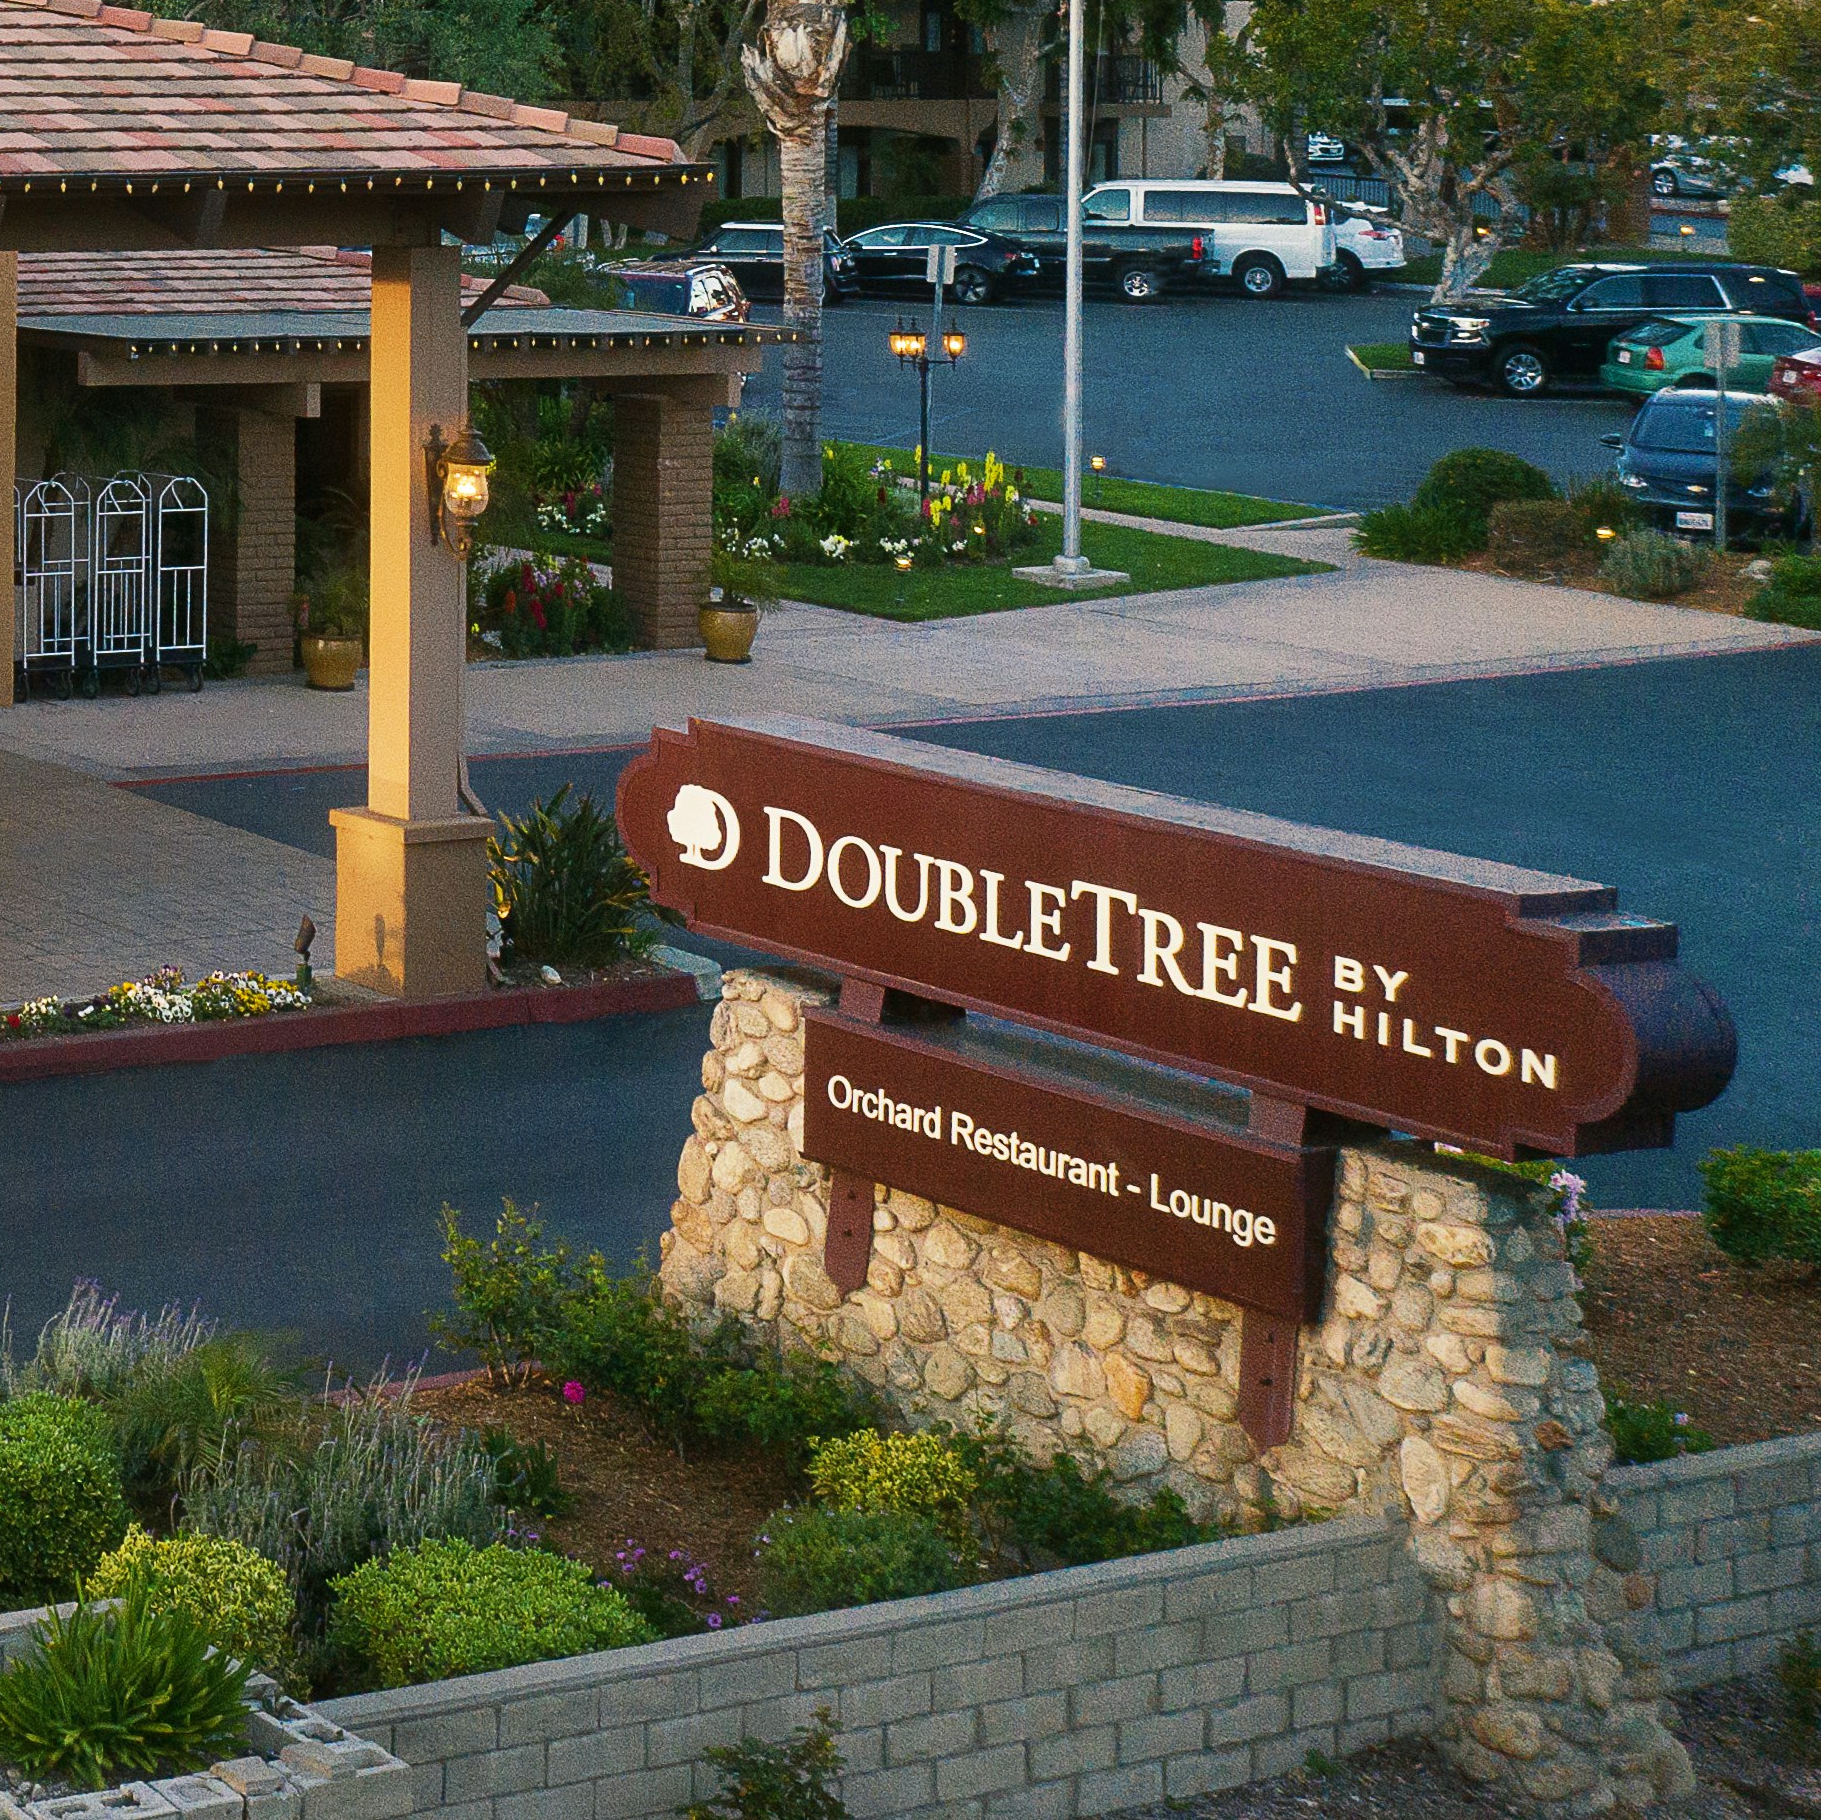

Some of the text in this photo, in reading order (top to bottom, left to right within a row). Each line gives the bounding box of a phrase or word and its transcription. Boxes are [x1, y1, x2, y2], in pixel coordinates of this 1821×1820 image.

[1333, 955, 1409, 1003] BY
[1333, 1001, 1557, 1090] HILTON
[827, 1074, 942, 1139] Orchard
[951, 1110, 1122, 1198] Restaurant
[1150, 1172, 1277, 1247] Lounge
